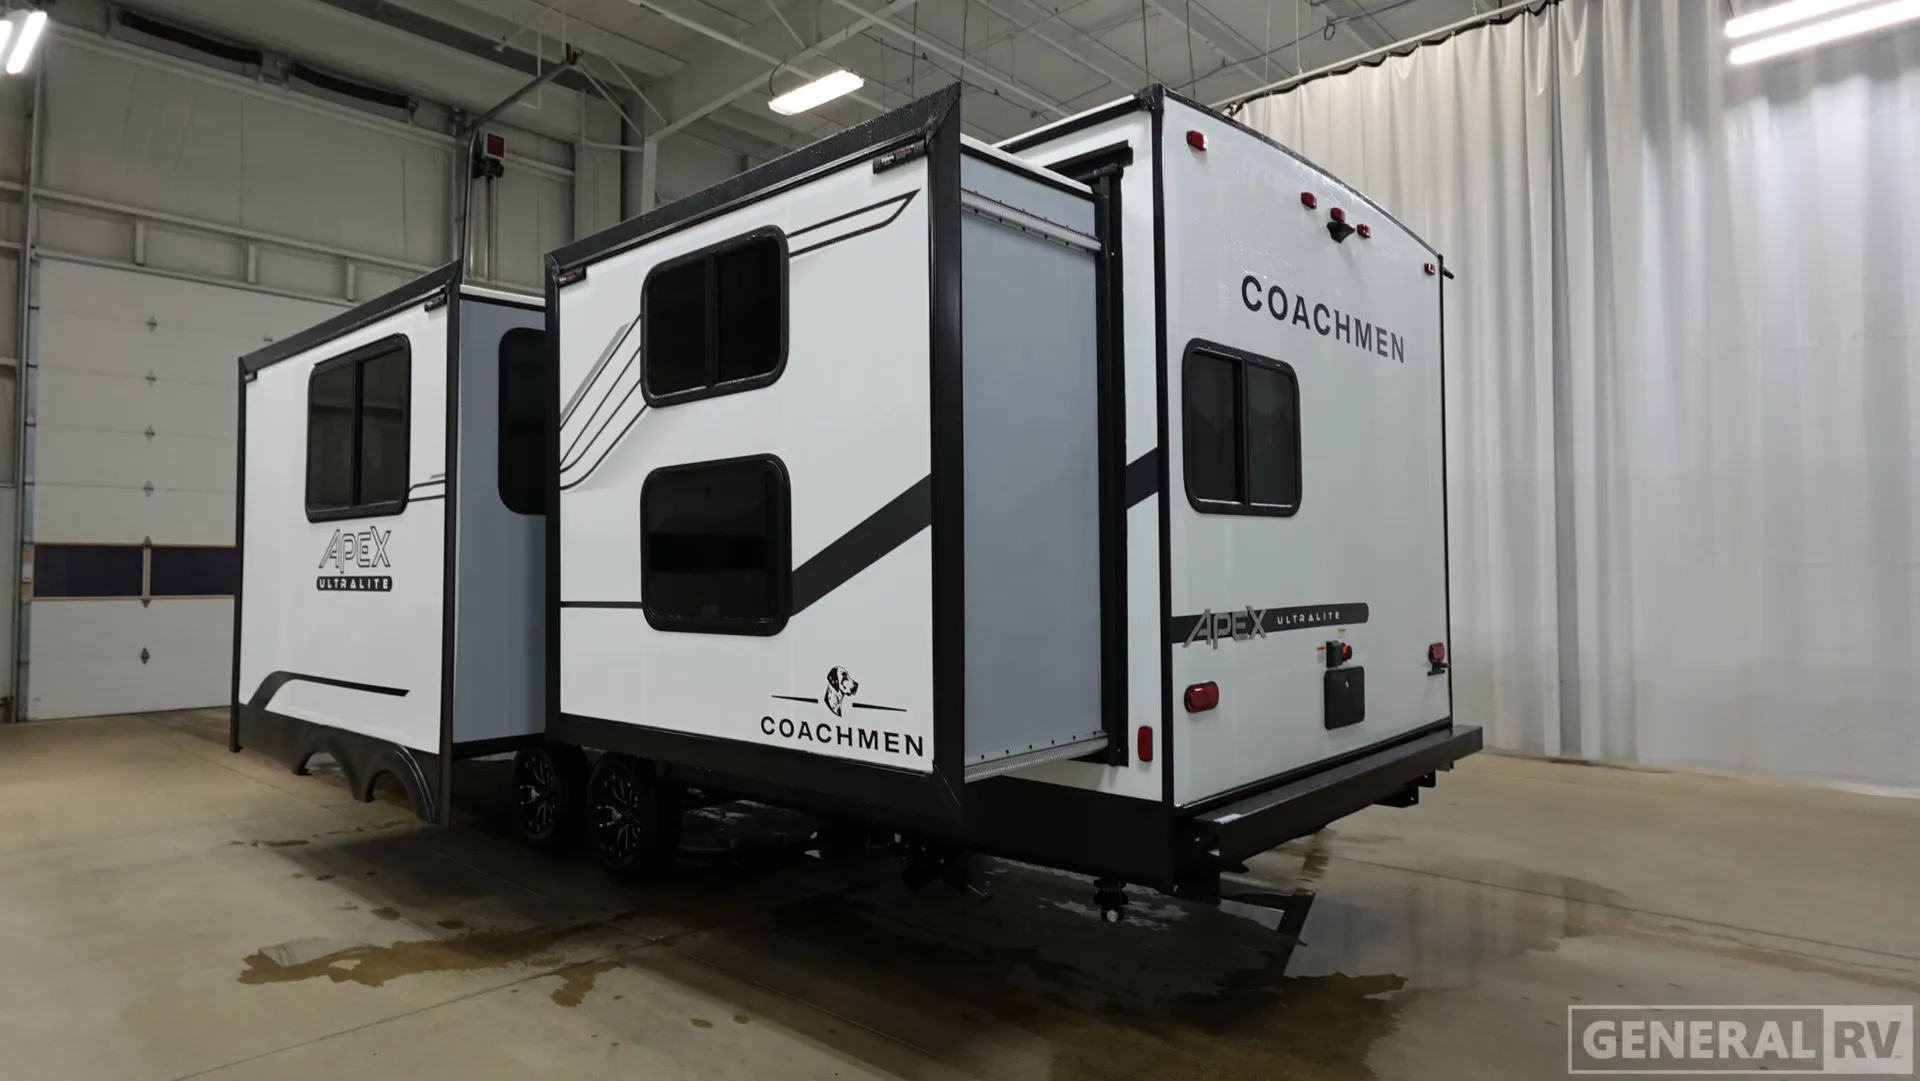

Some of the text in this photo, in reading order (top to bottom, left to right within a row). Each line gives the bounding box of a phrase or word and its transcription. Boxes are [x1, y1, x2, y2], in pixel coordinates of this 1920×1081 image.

[1241, 275, 1404, 363] COACHMEN
[319, 525, 391, 574] APEX
[319, 578, 389, 589] ULTRALITE
[1182, 605, 1340, 650] APEX ULTRALITE
[761, 716, 923, 757] COACHMEN
